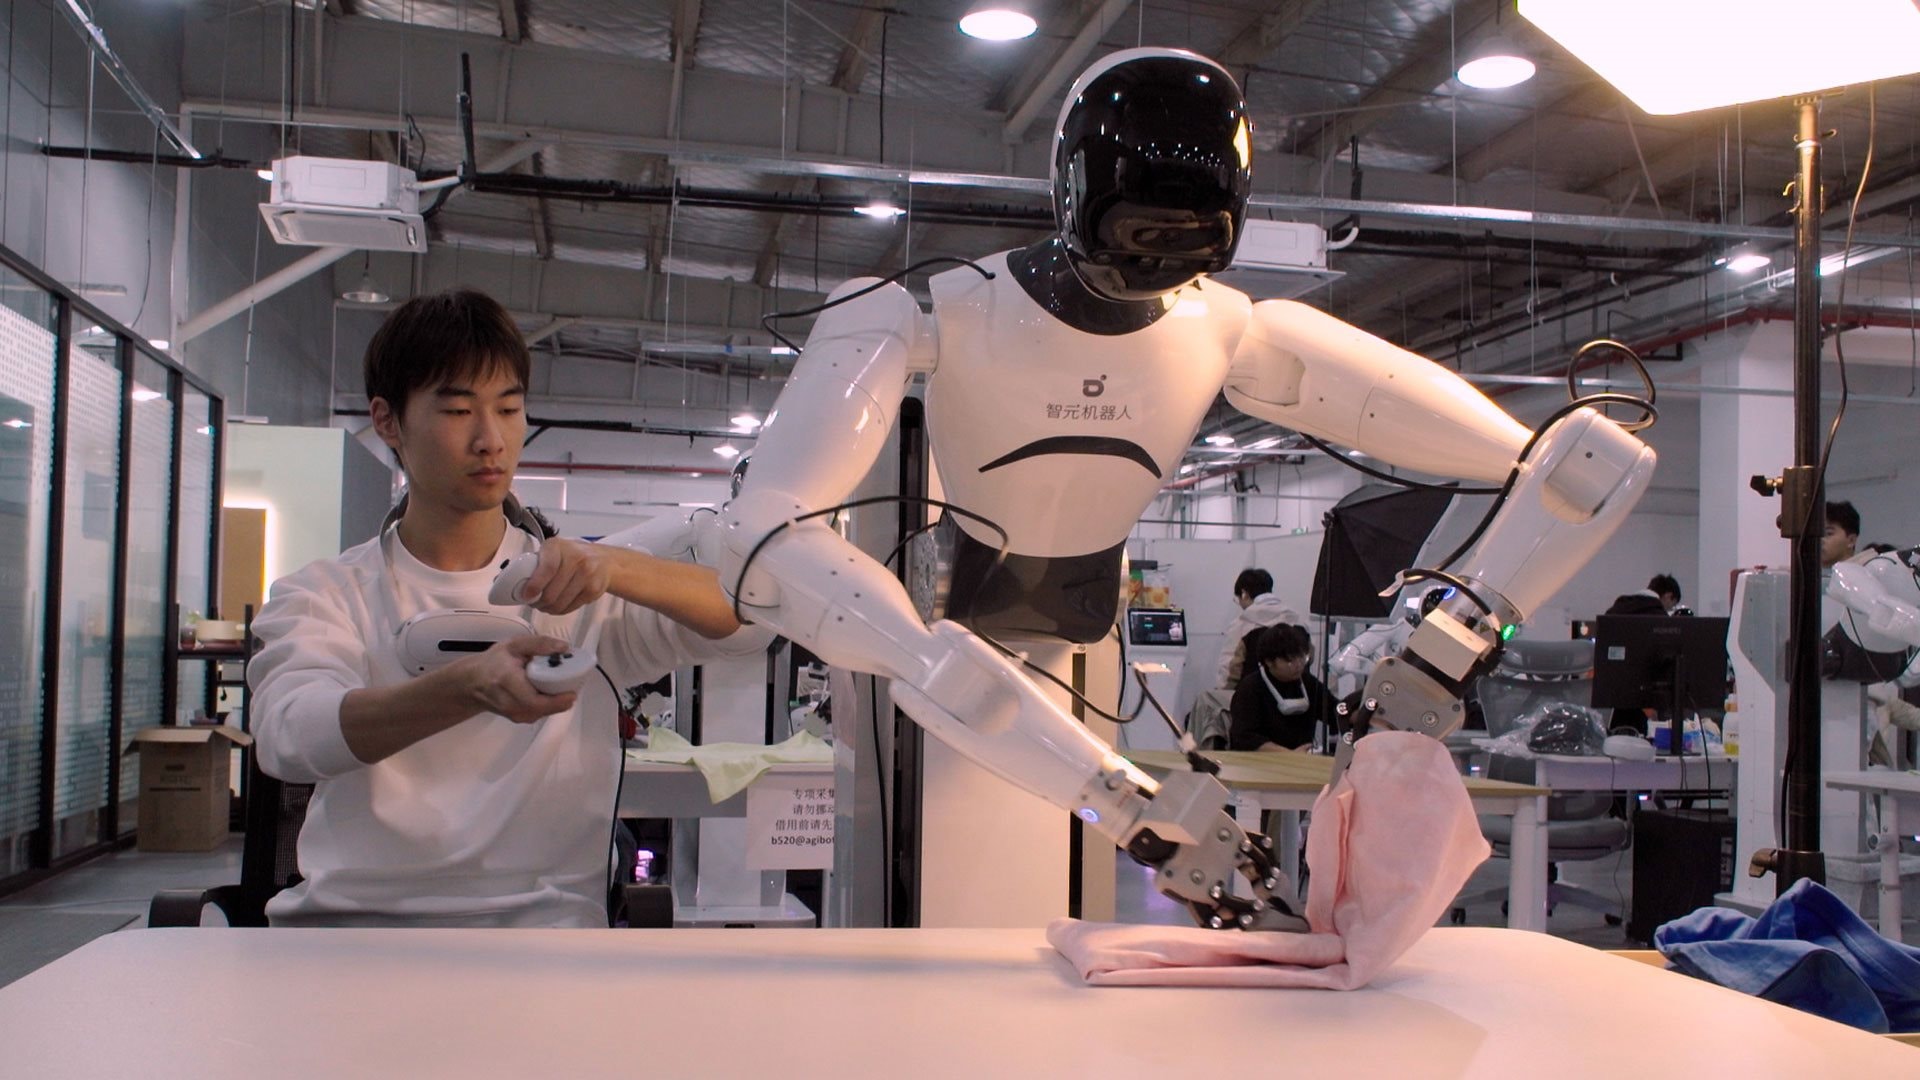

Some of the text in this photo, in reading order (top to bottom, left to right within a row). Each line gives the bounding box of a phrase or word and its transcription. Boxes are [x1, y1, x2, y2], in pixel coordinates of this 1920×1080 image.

[1046, 403, 1132, 421] 智元机器人
[776, 819, 832, 831] 借用前请先
